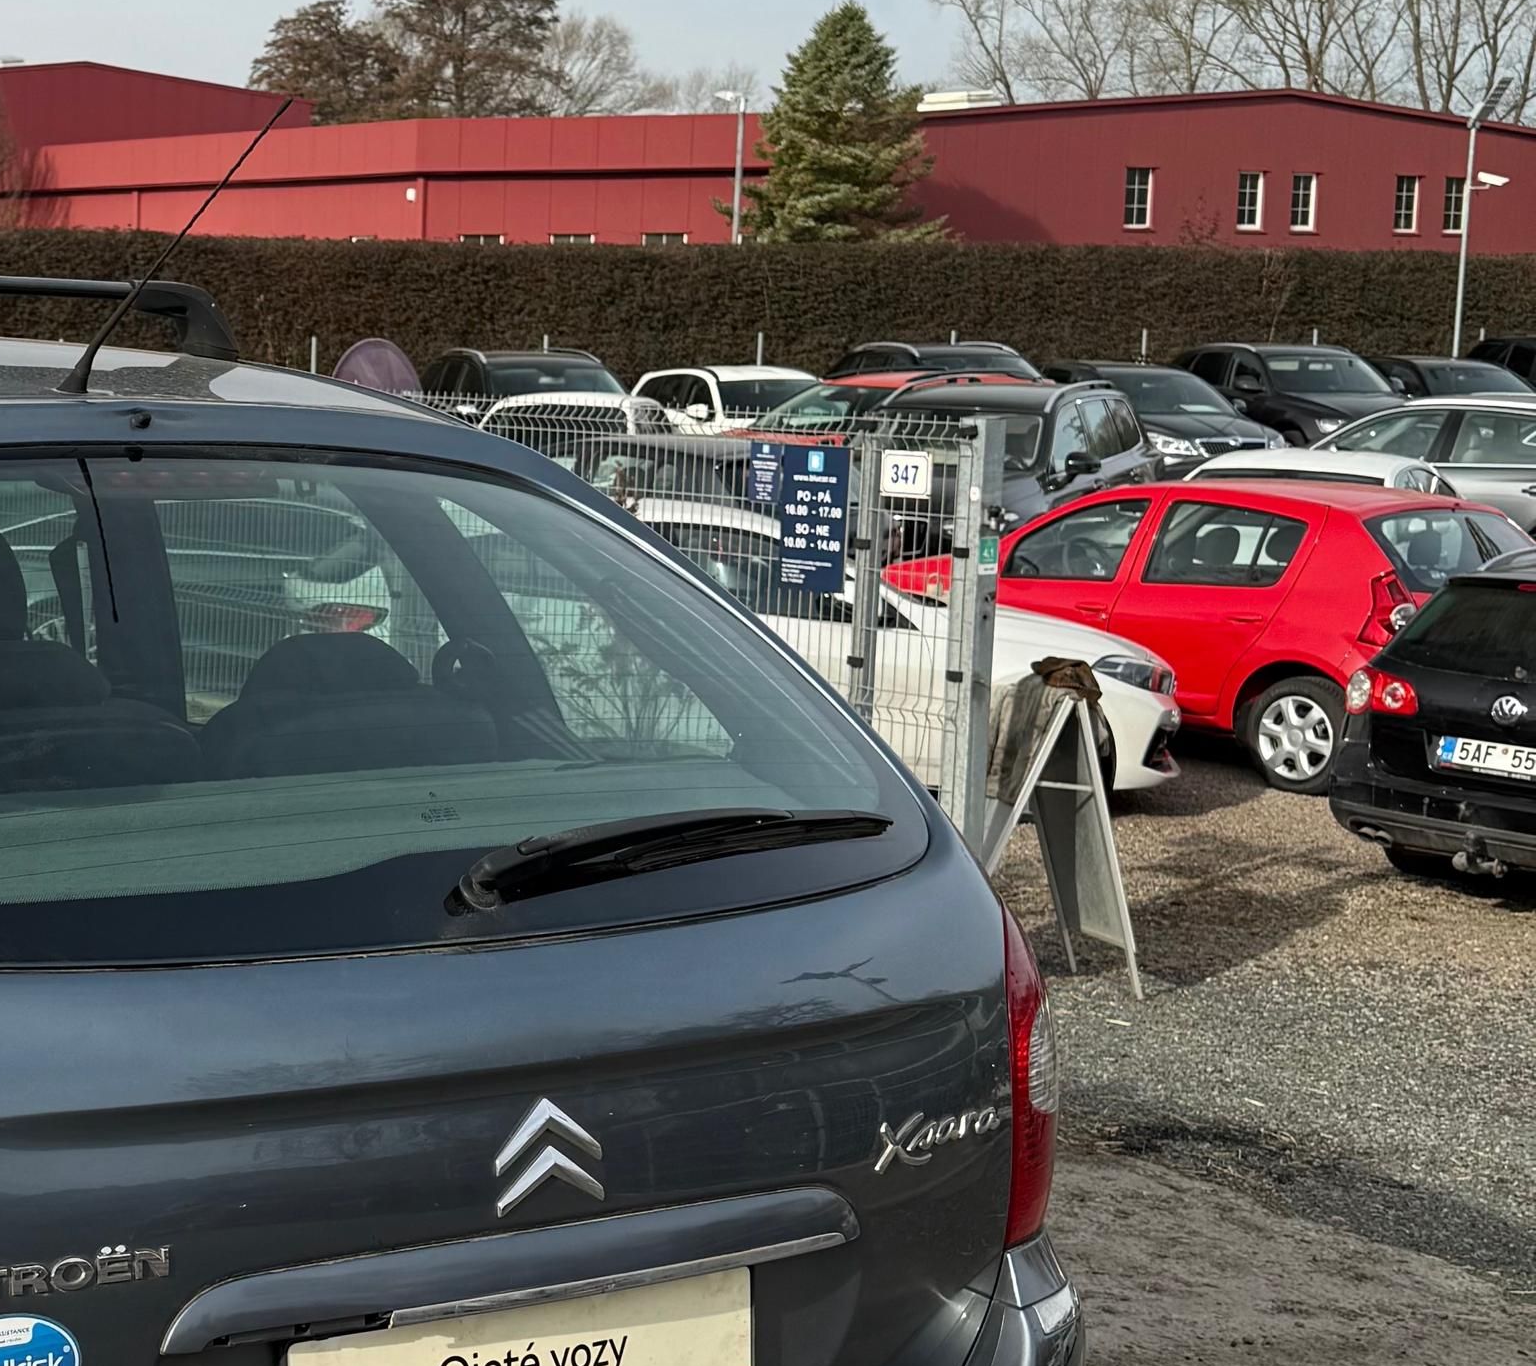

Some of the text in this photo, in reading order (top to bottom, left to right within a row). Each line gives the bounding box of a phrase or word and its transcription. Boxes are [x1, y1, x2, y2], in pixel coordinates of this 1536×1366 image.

[891, 464, 919, 485] 347
[796, 490, 811, 502] PO
[795, 522, 809, 535] SO
[816, 524, 830, 537] NE
[1458, 741, 1497, 764] 5AF
